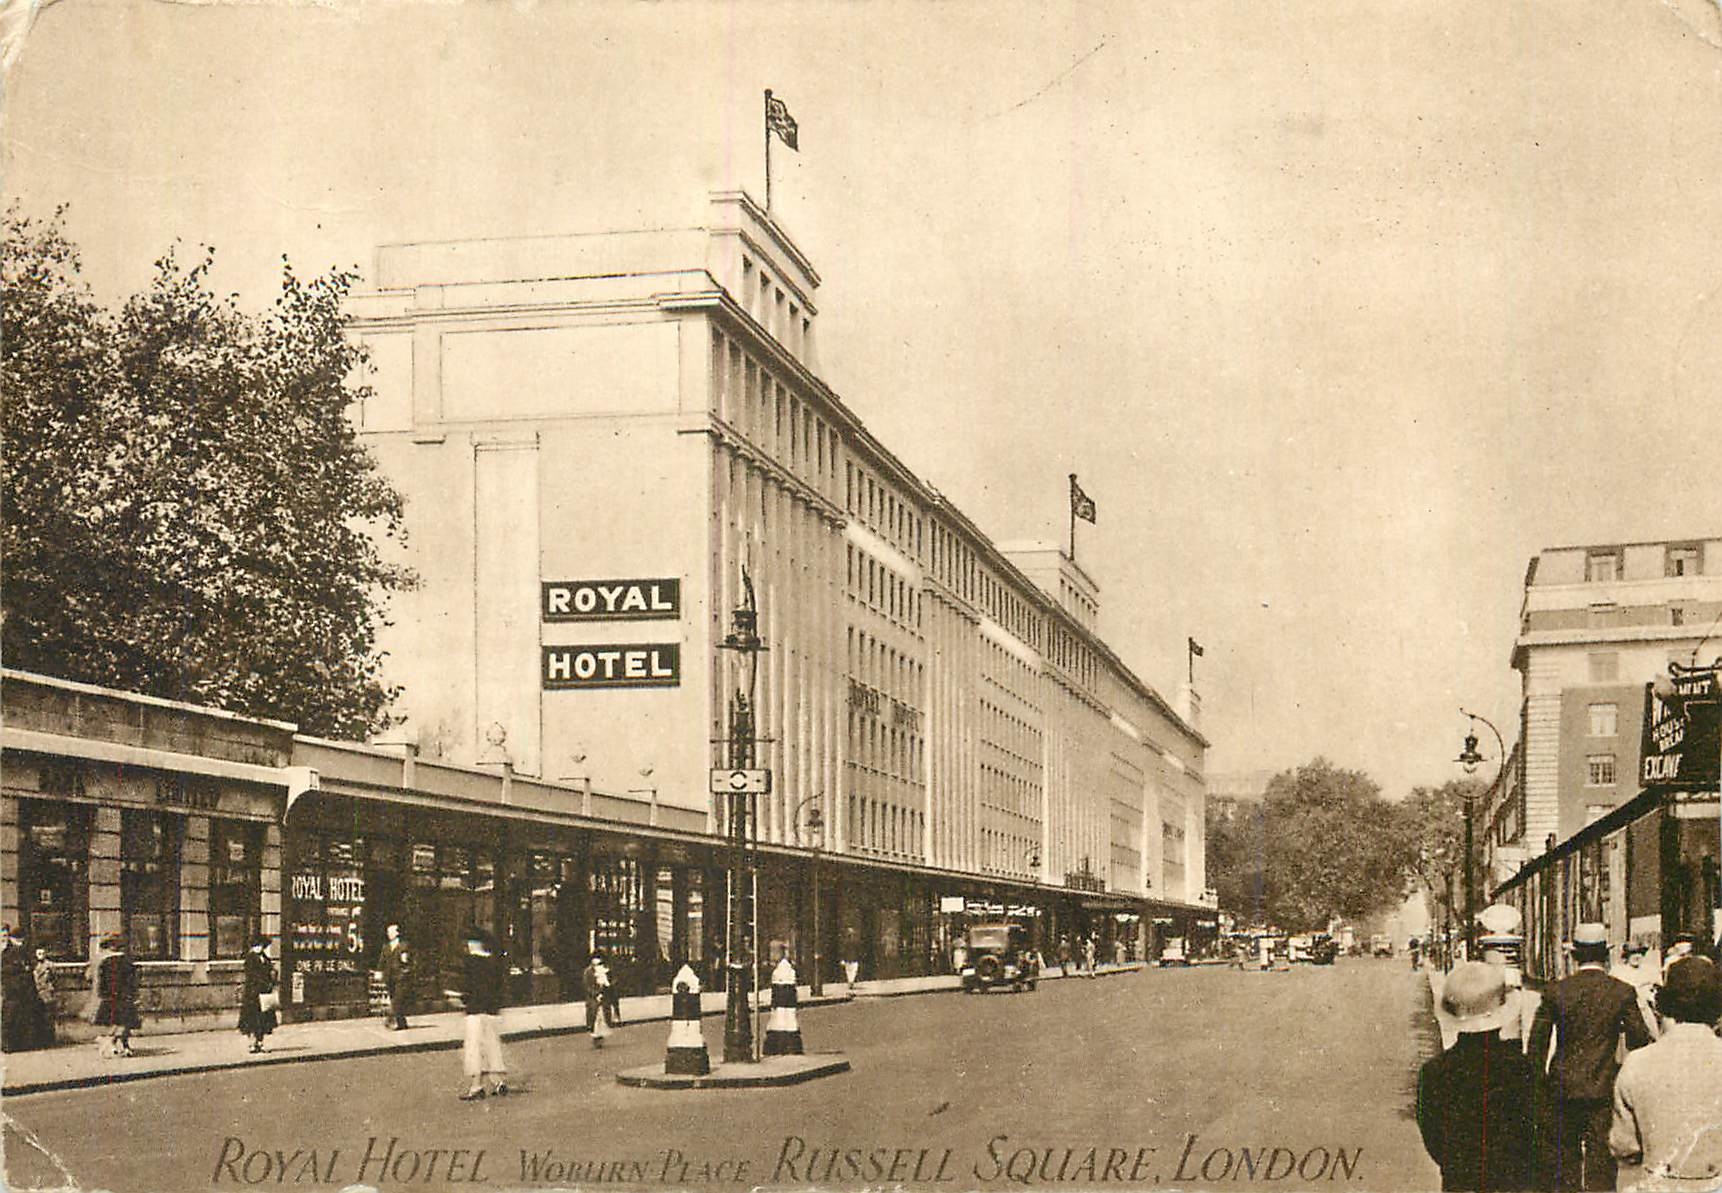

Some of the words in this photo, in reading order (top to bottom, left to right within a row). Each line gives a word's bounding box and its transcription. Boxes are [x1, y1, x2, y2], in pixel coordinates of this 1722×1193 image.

[549, 585, 672, 613] ROYAL
[549, 651, 672, 679] HOTEL
[329, 877, 366, 902] HOTEL
